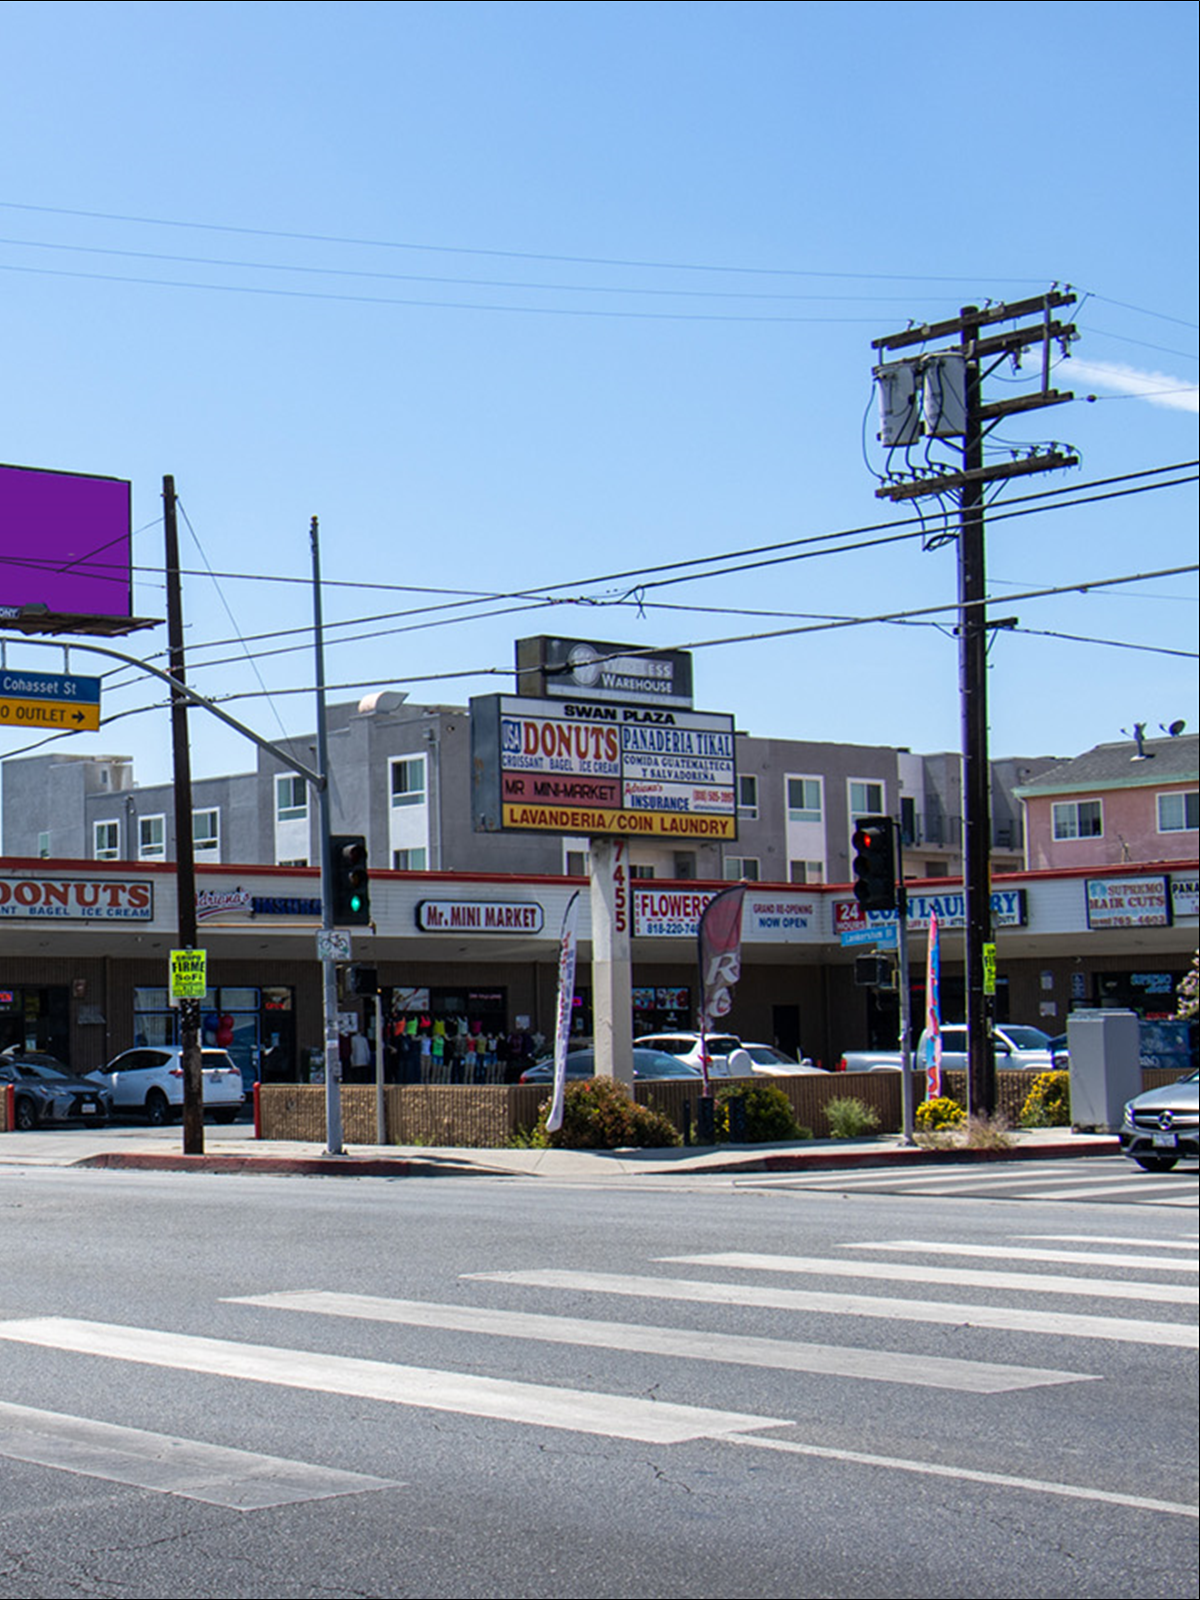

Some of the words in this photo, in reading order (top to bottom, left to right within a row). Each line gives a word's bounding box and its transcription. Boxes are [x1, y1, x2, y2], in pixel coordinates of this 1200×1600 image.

[3, 676, 58, 694] Cohasset
[63, 682, 77, 695] St
[602, 673, 672, 693] WAREHOUSE
[16, 706, 66, 722] OUTLET
[564, 705, 617, 720] SWAN
[623, 710, 676, 725] PLAZA
[523, 722, 618, 762] DONUTS
[623, 728, 694, 754] PANADERIA
[696, 734, 732, 757] TIKAL
[502, 755, 544, 769] CROISSANT
[550, 758, 573, 771] BAGEL
[580, 760, 592, 773] ICE
[593, 761, 619, 774] CREAM
[623, 755, 659, 766] COMIDA
[661, 758, 731, 771] GUATEMALTECA
[642, 768, 648, 778] Y
[505, 780, 525, 795] MR
[534, 782, 616, 801] MINI-MARKET
[631, 795, 689, 811] INSURANCE
[510, 808, 653, 832] LAVANDERIA/COIN
[660, 817, 728, 836] LAUNDRY
[613, 841, 626, 932] 7455
[1108, 883, 1164, 896] SUPREMO
[753, 903, 774, 914] GRAND
[1090, 898, 1124, 910] HAIR
[1128, 896, 1166, 908] CUTS
[29, 907, 70, 916] BAGEL
[82, 907, 103, 917] ICE
[106, 908, 150, 917] CREAM
[427, 906, 448, 926] Mr.
[451, 907, 480, 927] MINI
[485, 907, 536, 928] MARKET
[840, 904, 859, 920] 24
[759, 917, 780, 928] NOW
[782, 917, 807, 928] OPEN
[836, 921, 867, 932] HOURS
[171, 961, 205, 973] FIRME
